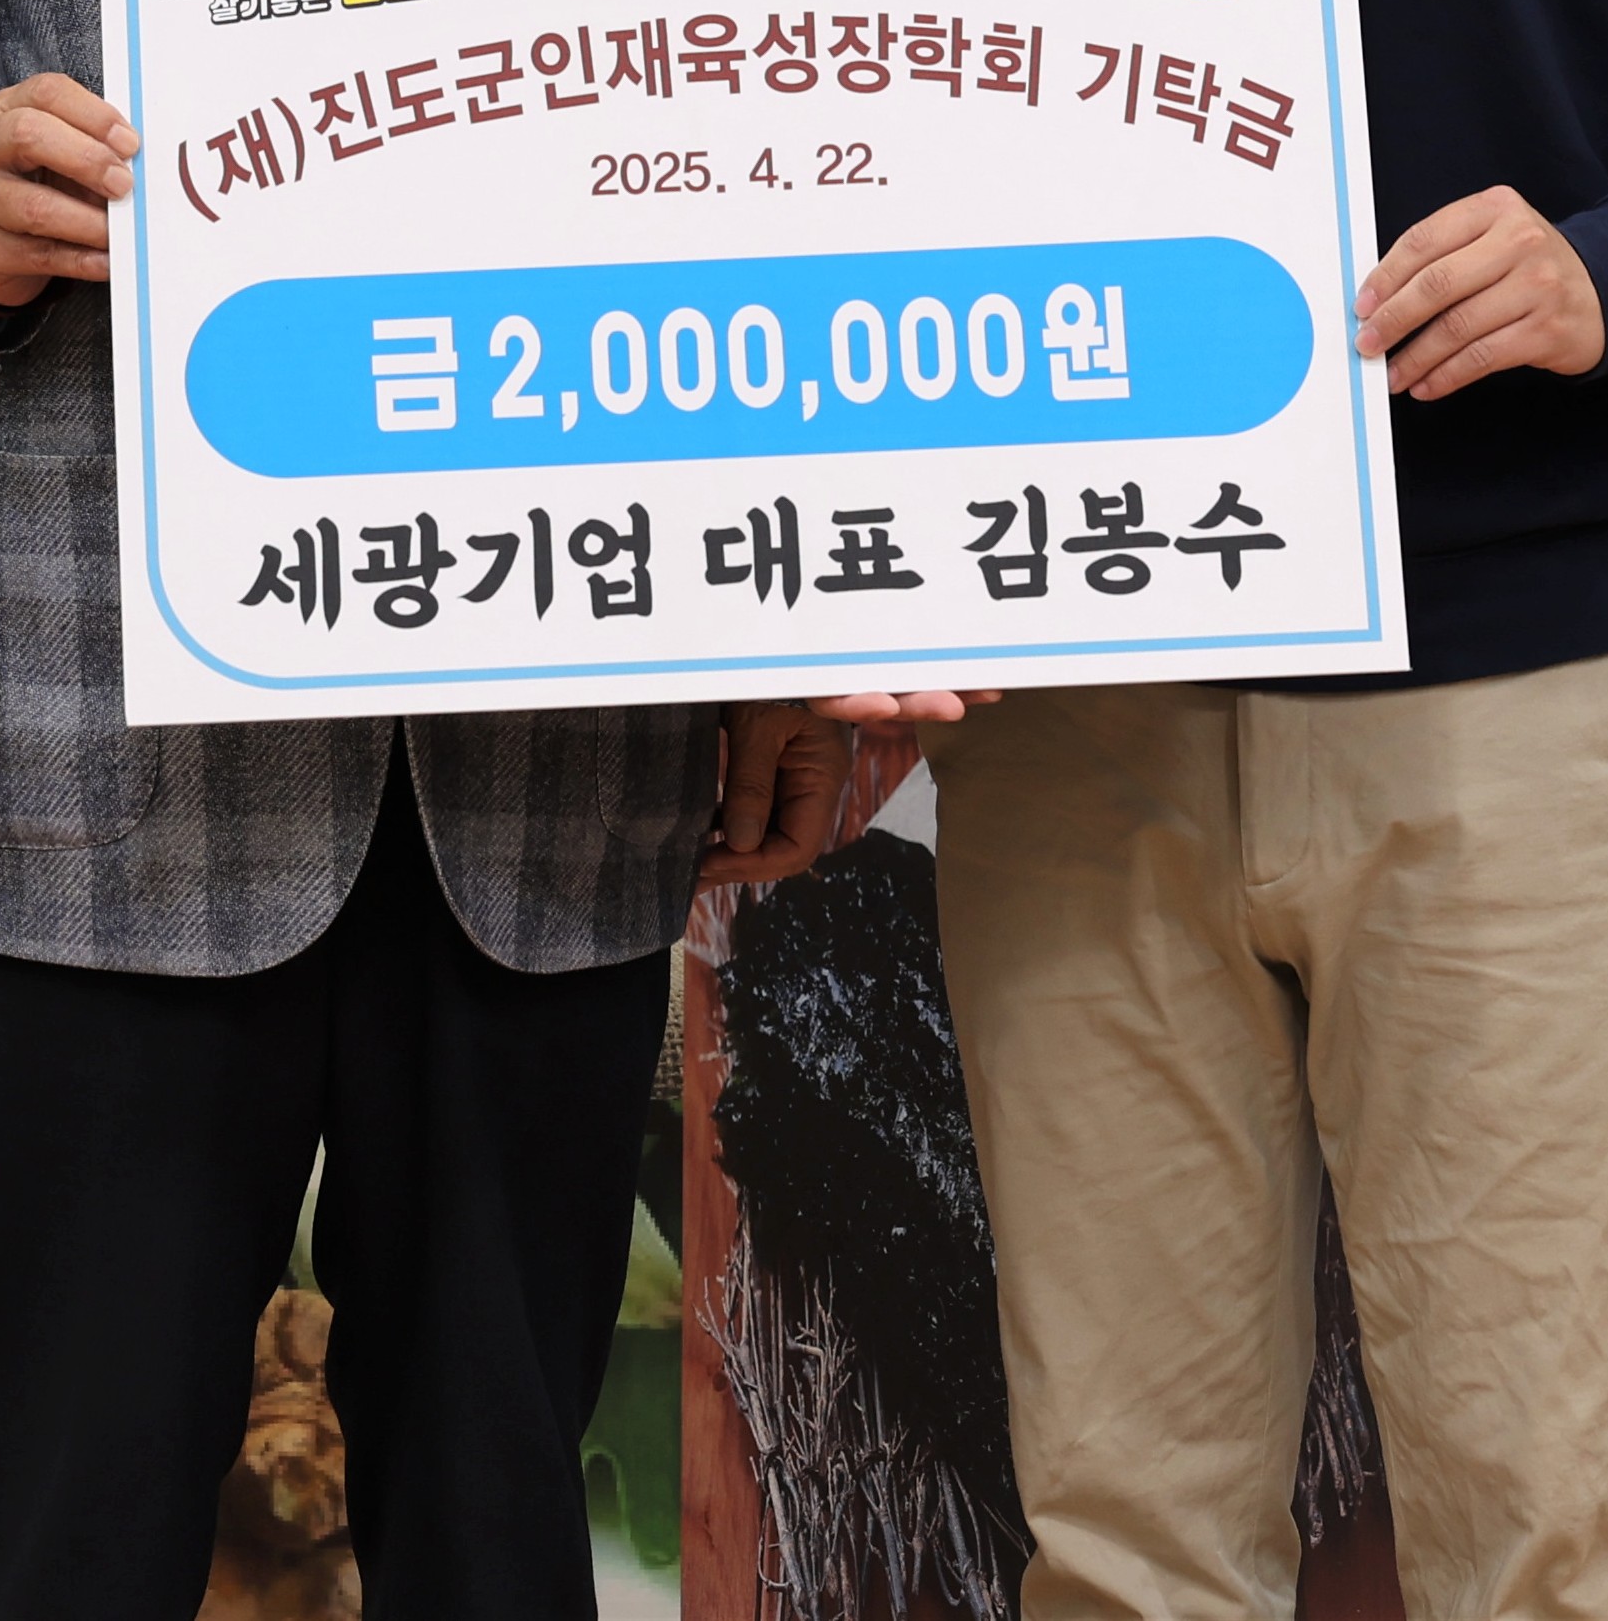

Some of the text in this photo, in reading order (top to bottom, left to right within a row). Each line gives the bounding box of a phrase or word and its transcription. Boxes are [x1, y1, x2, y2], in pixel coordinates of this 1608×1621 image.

[177, 12, 1294, 223] (재)진도군인재육성장학회 기탁금
[592, 143, 887, 196] 2025. 4. 22.
[239, 481, 1286, 631] 세광기업 대표 김봉수
